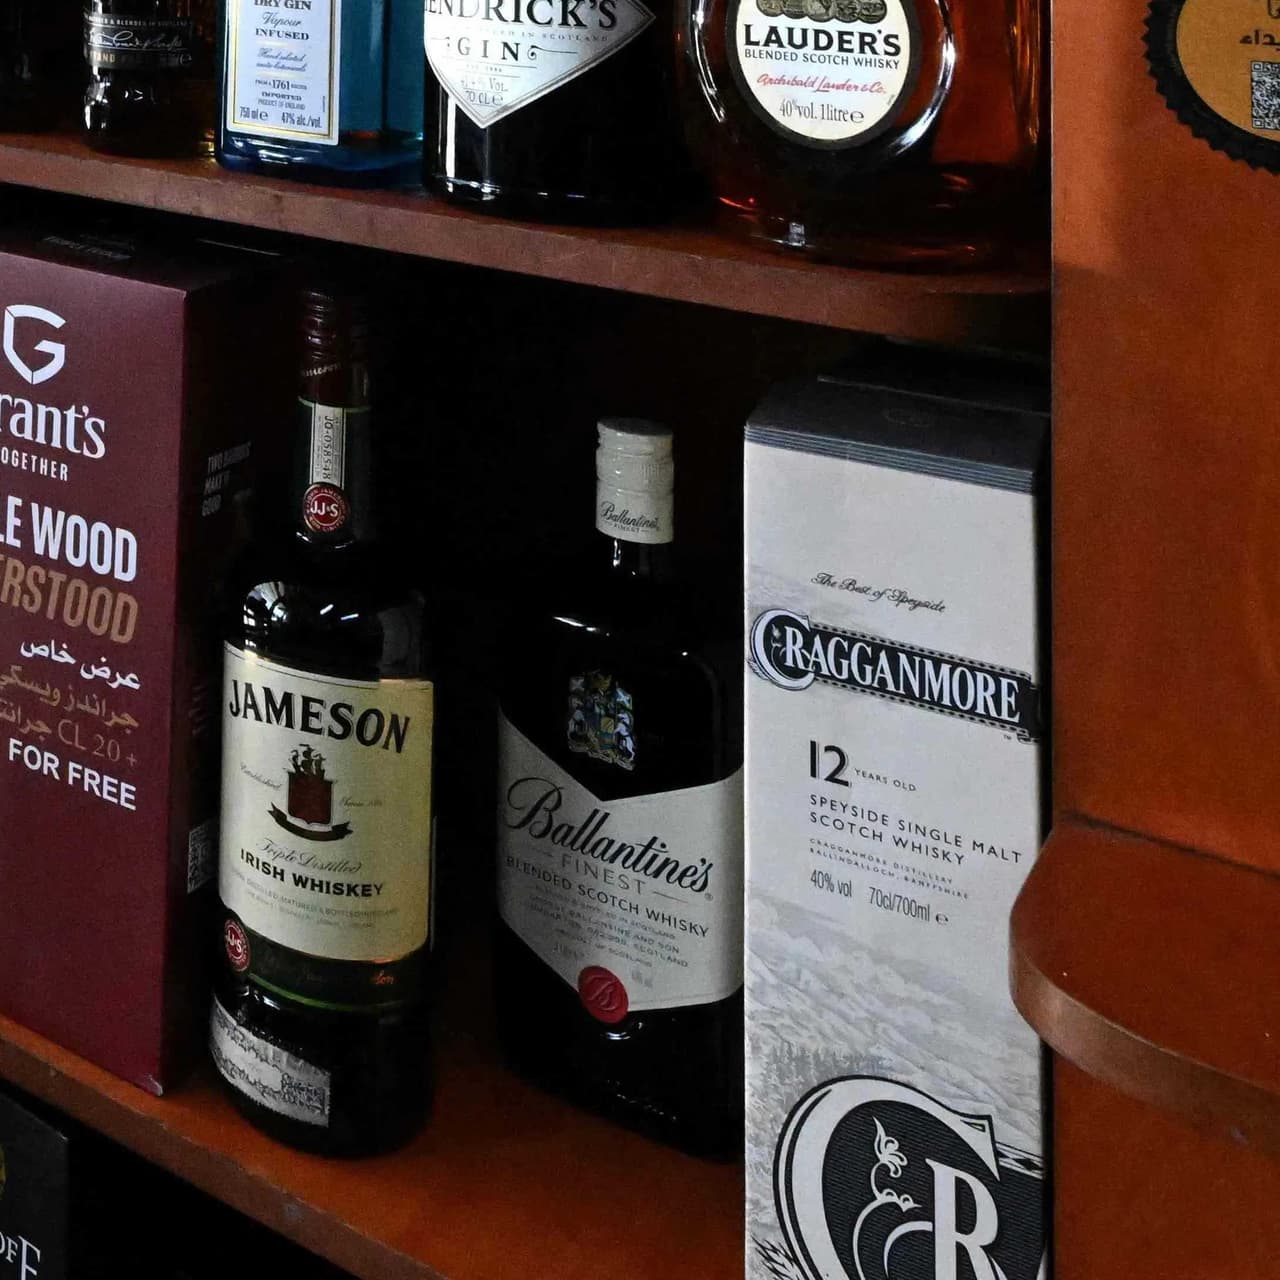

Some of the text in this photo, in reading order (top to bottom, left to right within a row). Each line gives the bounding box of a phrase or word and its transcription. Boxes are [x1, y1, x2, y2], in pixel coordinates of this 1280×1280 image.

[262, 11, 302, 29] Vapour
[284, 0, 313, 11] GIN
[255, 28, 310, 41] INFUSED
[457, 37, 521, 61] GIN
[744, 24, 902, 57] LAUDER'S
[744, 49, 901, 70] BLENDED SCOTCH WHISKY
[261, 91, 302, 101] IMPORTED
[272, 79, 290, 90] 1761
[756, 73, 817, 88] Archibald
[813, 75, 859, 93] Lauder
[601, 500, 658, 529] Ballantine's
[31, 502, 138, 583] WOOD
[811, 572, 946, 613] The Best of Speyside
[20, 639, 140, 690] عرض خاص
[751, 608, 1022, 723] CRAGGANMORE
[58, 720, 86, 751] CL
[229, 679, 410, 754] JAMESON
[94, 734, 121, 762] 20
[810, 740, 917, 792] 12 YEARS OLD
[9, 737, 137, 811] FOR FREE
[506, 776, 714, 894] Ballantine's
[810, 794, 1022, 864] SPEYSIDE SINGLE MALT
[810, 811, 965, 865] SCOTCH WHISKY
[240, 849, 383, 898] IRISH WHISKEY
[256, 837, 362, 875] Triple Distilled
[561, 854, 647, 895] FINEST
[810, 838, 953, 884] CRAGGANMORE DISTILLERY
[506, 856, 572, 890] BLENDED
[577, 884, 640, 916] SCOTCH
[645, 907, 710, 938] WHISKY
[810, 869, 931, 922] 40% vol 70cl/700ml
